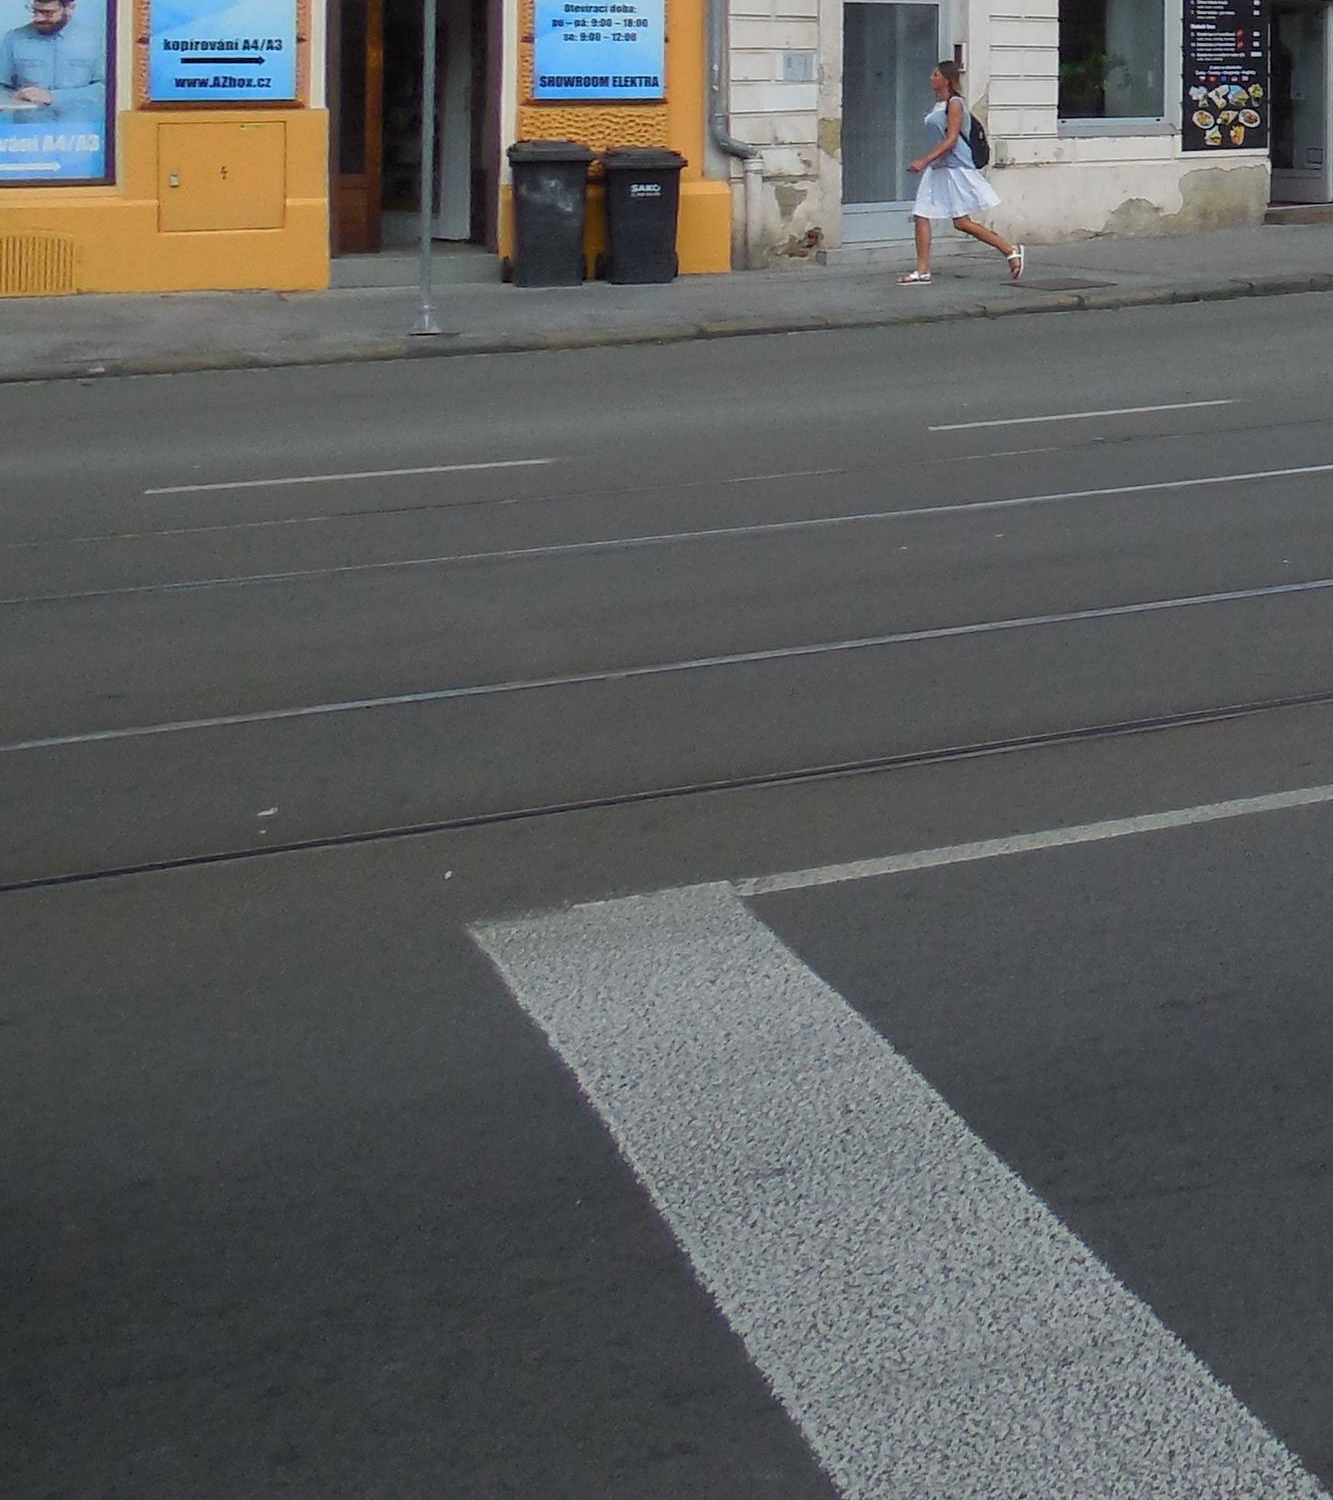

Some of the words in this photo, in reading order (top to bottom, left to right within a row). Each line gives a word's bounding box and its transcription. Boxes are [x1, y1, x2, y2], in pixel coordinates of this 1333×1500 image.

[609, 4, 638, 14] doba:
[591, 18, 613, 28] 9:00
[623, 18, 649, 28] 18:00
[579, 32, 602, 42] 9:00
[611, 33, 638, 42] 12:00
[163, 38, 239, 53] kopírování
[241, 38, 284, 51] A4/A3
[174, 76, 272, 89] www.AZbox.cz
[539, 75, 611, 88] SHOWROOM
[612, 75, 661, 88] ELEKTRA
